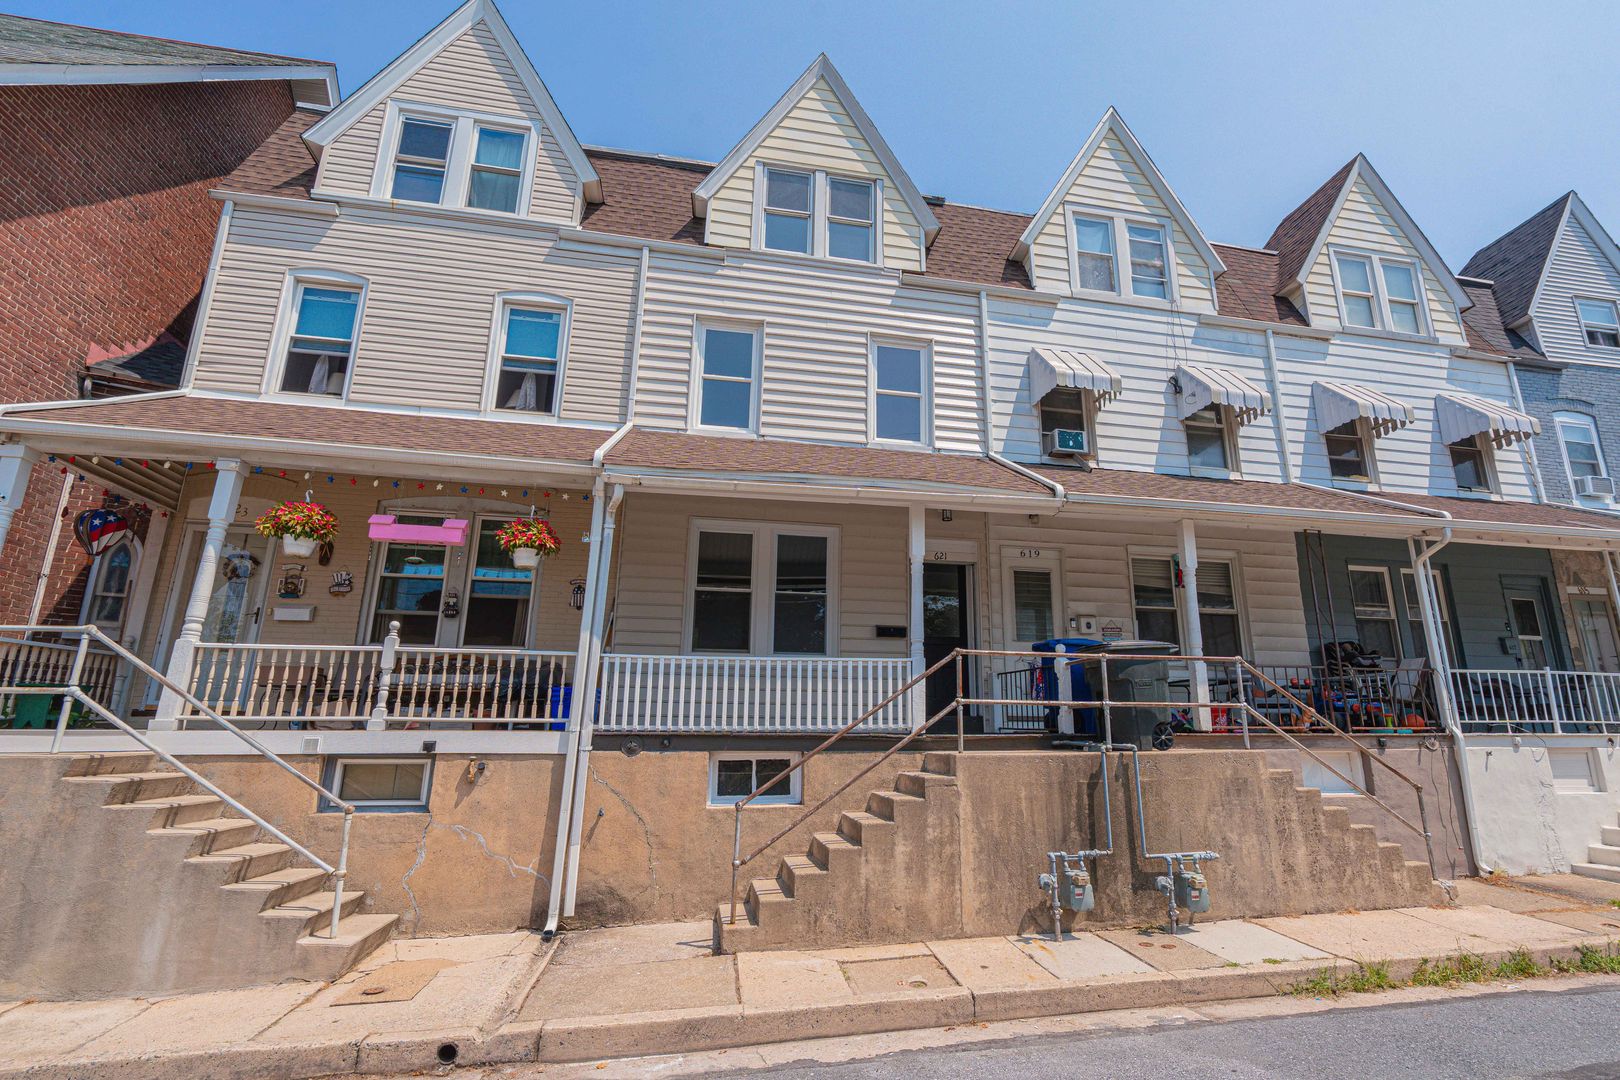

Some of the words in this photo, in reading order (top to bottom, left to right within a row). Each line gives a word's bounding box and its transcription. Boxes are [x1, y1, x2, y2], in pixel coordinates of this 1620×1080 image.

[235, 504, 248, 517] 23
[934, 552, 947, 560] 621
[1020, 549, 1040, 558] 619
